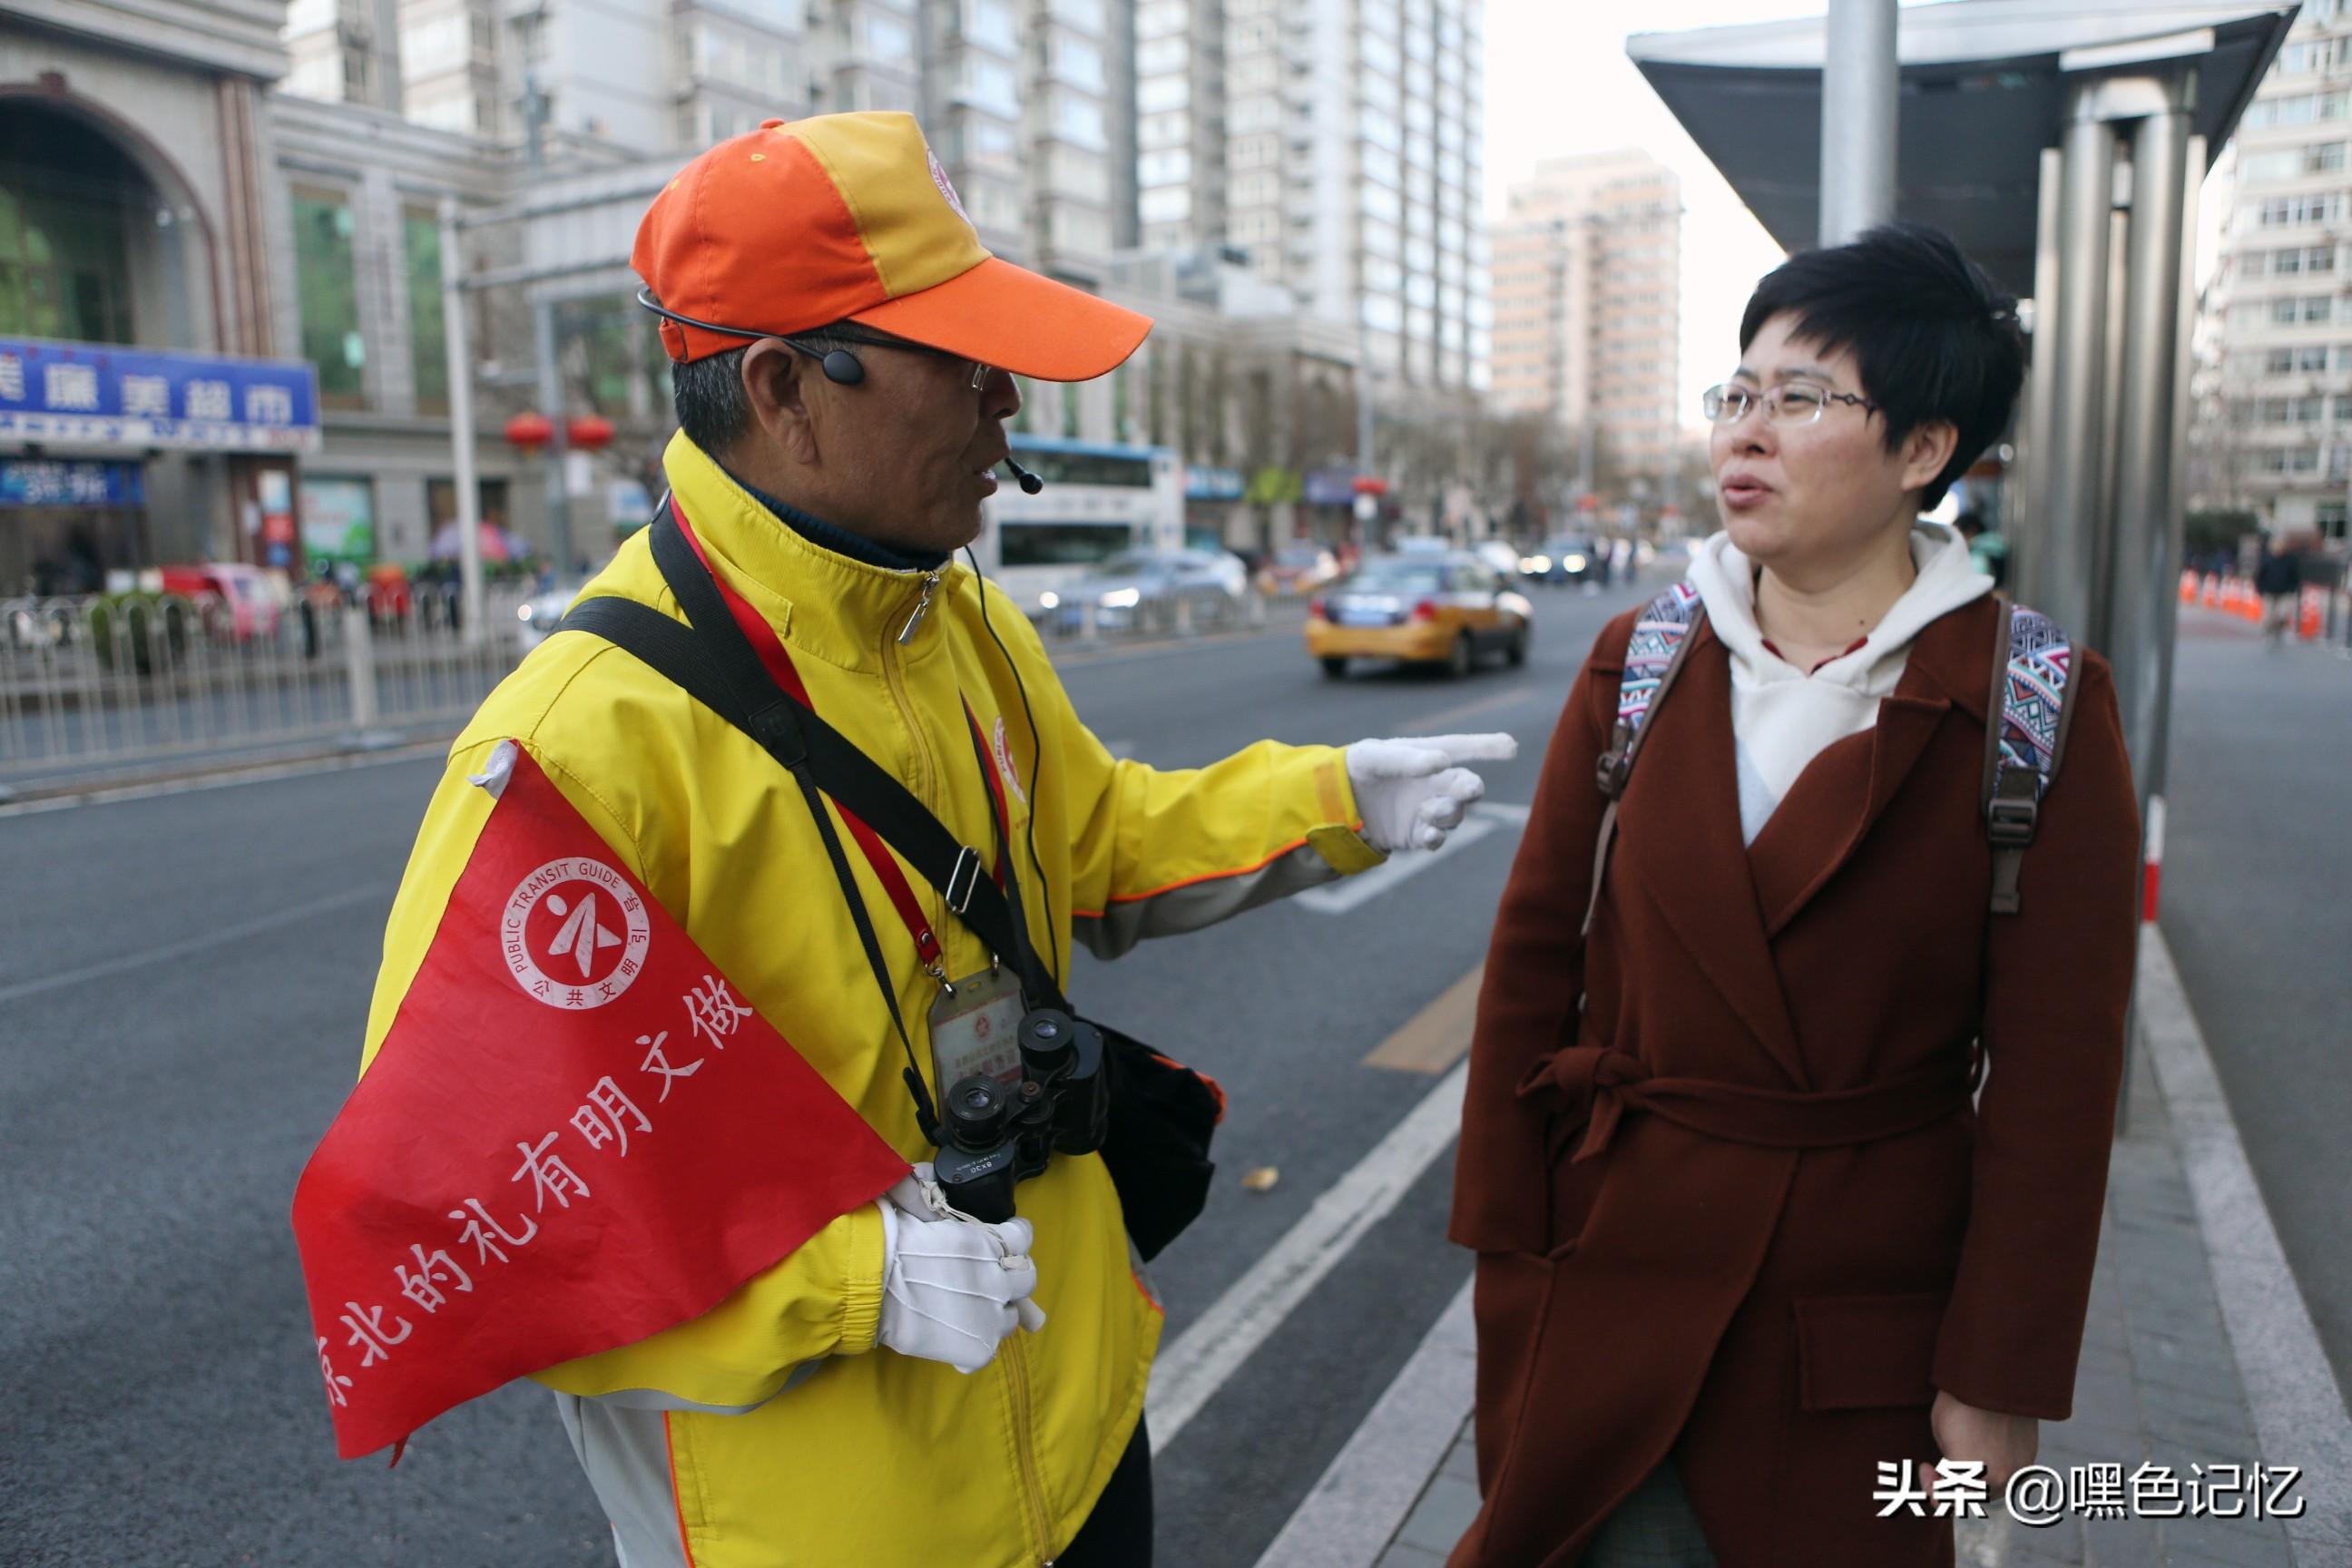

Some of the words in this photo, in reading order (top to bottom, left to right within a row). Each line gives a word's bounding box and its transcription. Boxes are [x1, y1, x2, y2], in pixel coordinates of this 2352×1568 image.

[513, 863, 569, 909] TRANSIT
[579, 862, 621, 888] GUIDE
[505, 918, 528, 973] PUBLIC
